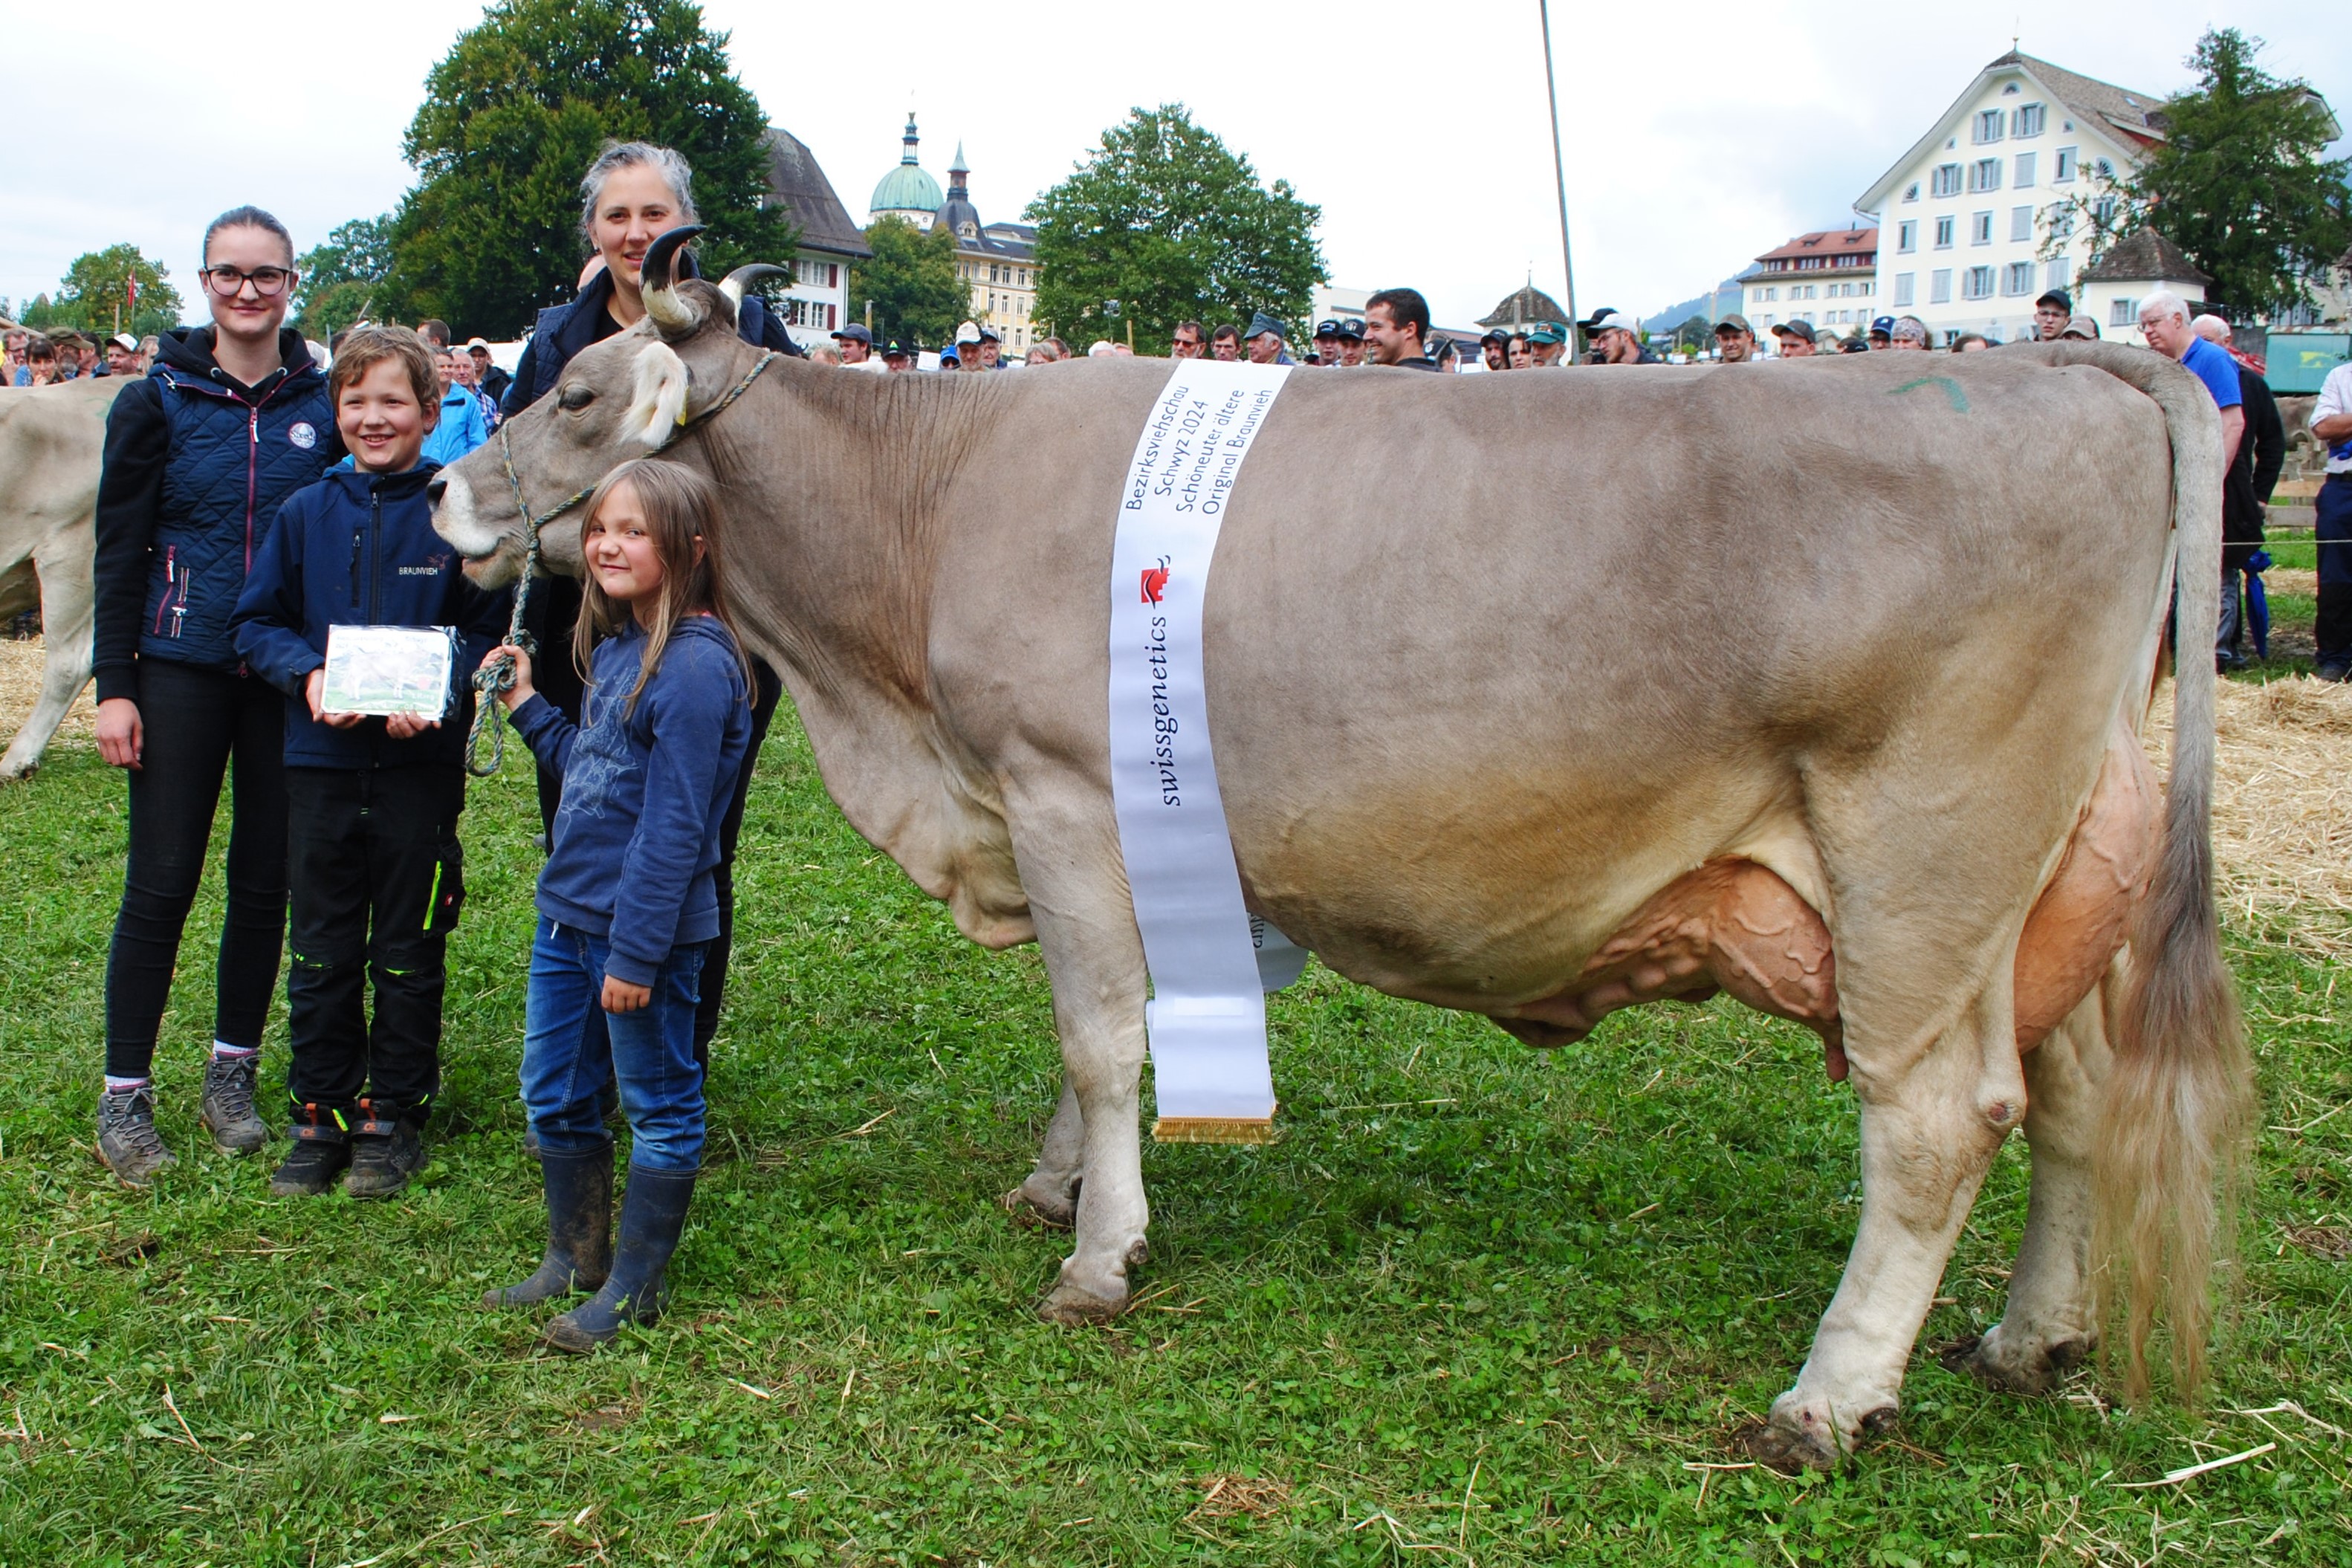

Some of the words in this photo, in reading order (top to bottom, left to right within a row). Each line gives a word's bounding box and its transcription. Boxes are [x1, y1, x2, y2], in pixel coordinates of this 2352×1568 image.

[1125, 385, 1190, 511] Bezirksviehschau
[1154, 439, 1190, 496] Schwyz
[1178, 400, 1208, 435] 2024
[1176, 428, 1222, 513] Schöneuter
[1213, 390, 1244, 426] ältere
[1202, 453, 1237, 515] Original
[1226, 389, 1273, 448] Braunvieh
[398, 566, 438, 575] BRAUNVIEH
[1144, 616, 1180, 807] swissgenetics
